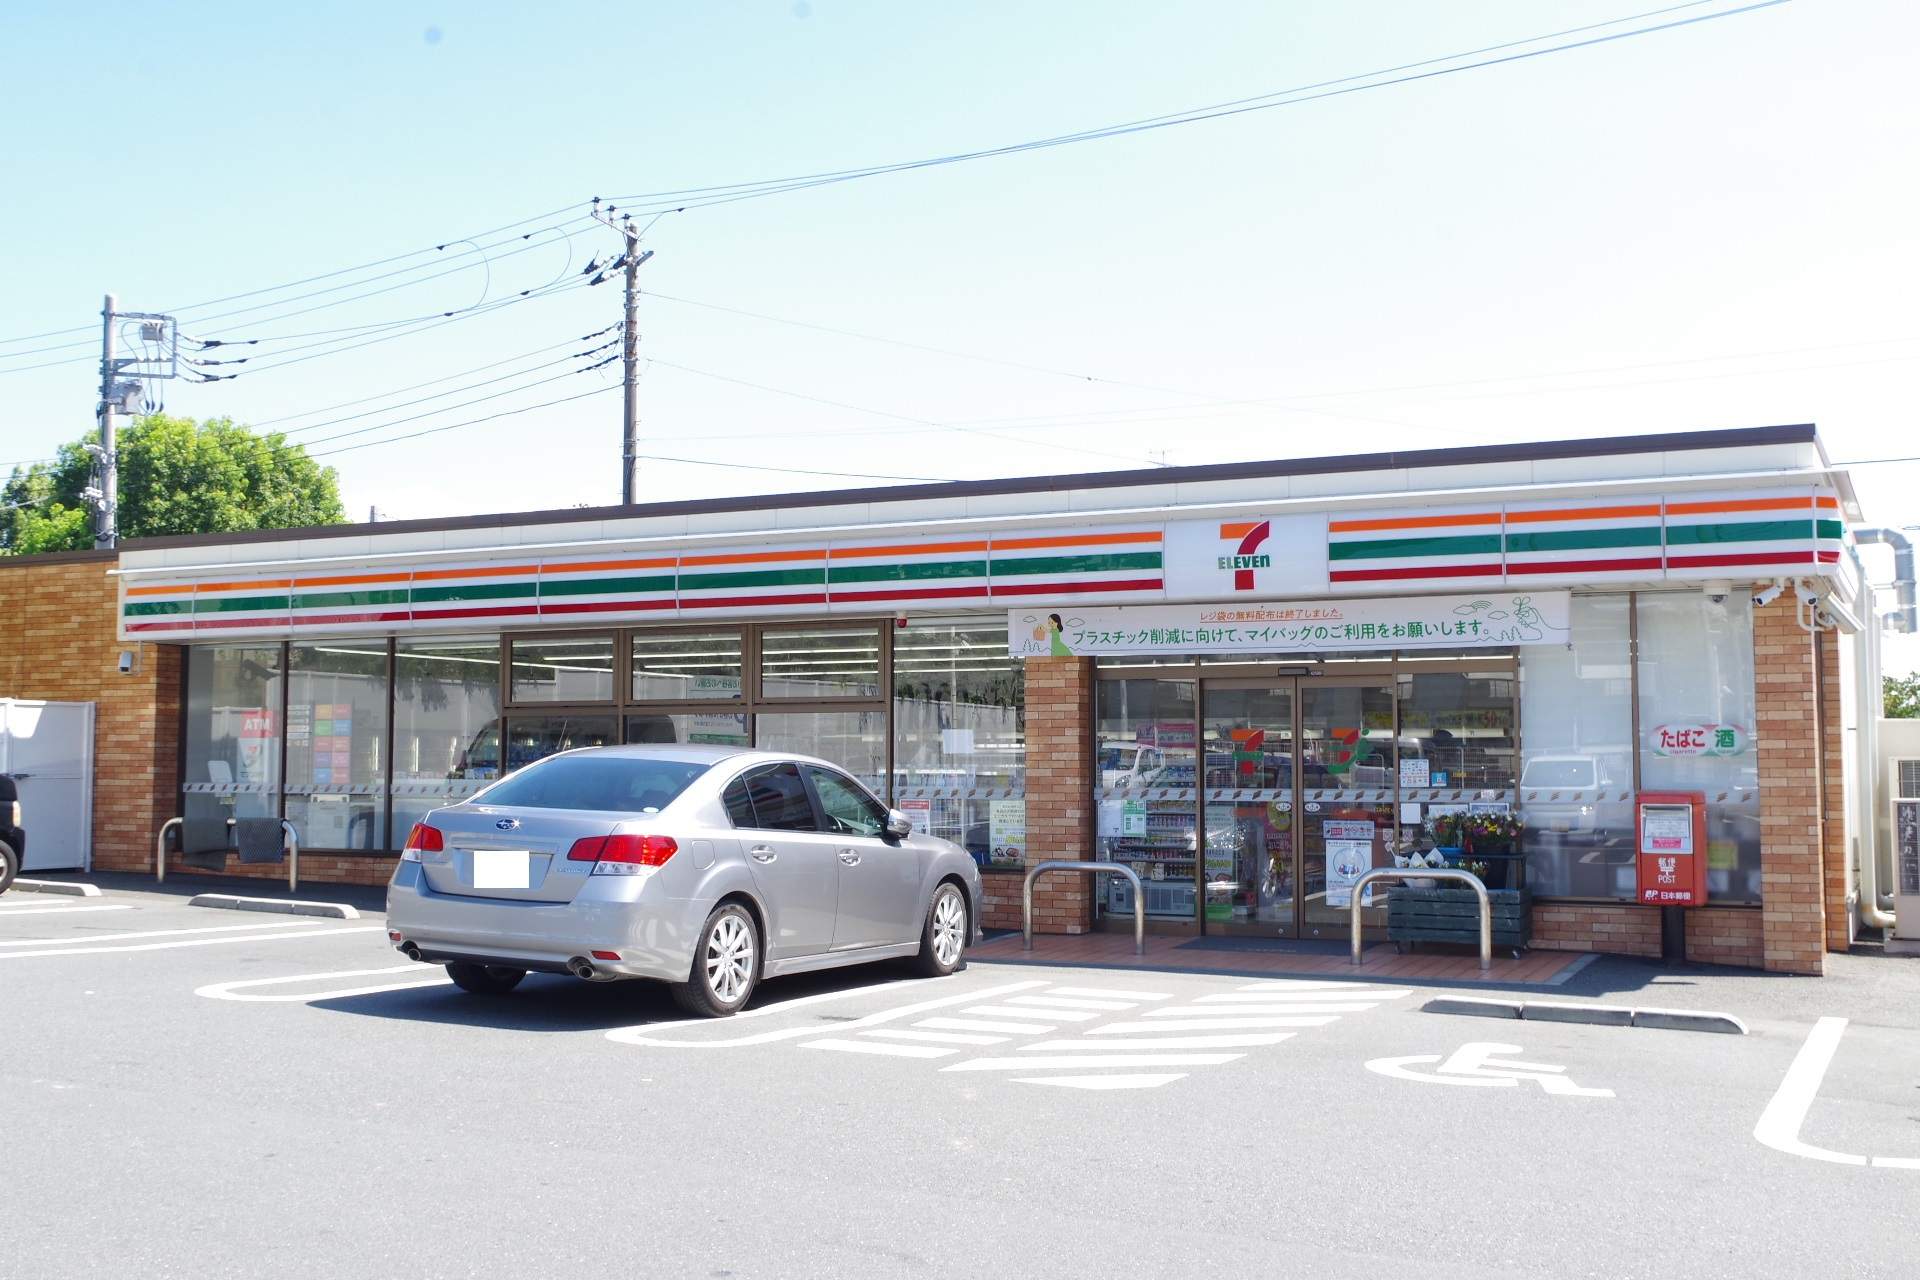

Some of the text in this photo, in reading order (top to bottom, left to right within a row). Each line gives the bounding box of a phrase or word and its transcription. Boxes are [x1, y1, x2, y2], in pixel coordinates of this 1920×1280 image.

[1200, 608, 1344, 621] レジ袋の無料配布は終了しました。
[1072, 619, 1489, 645] プラスチック削減に向けて、マイバッグのご利用をお願いします。
[244, 717, 271, 731] ATM
[1661, 729, 1735, 748] たばこ 酒
[1658, 875, 1676, 884] POST
